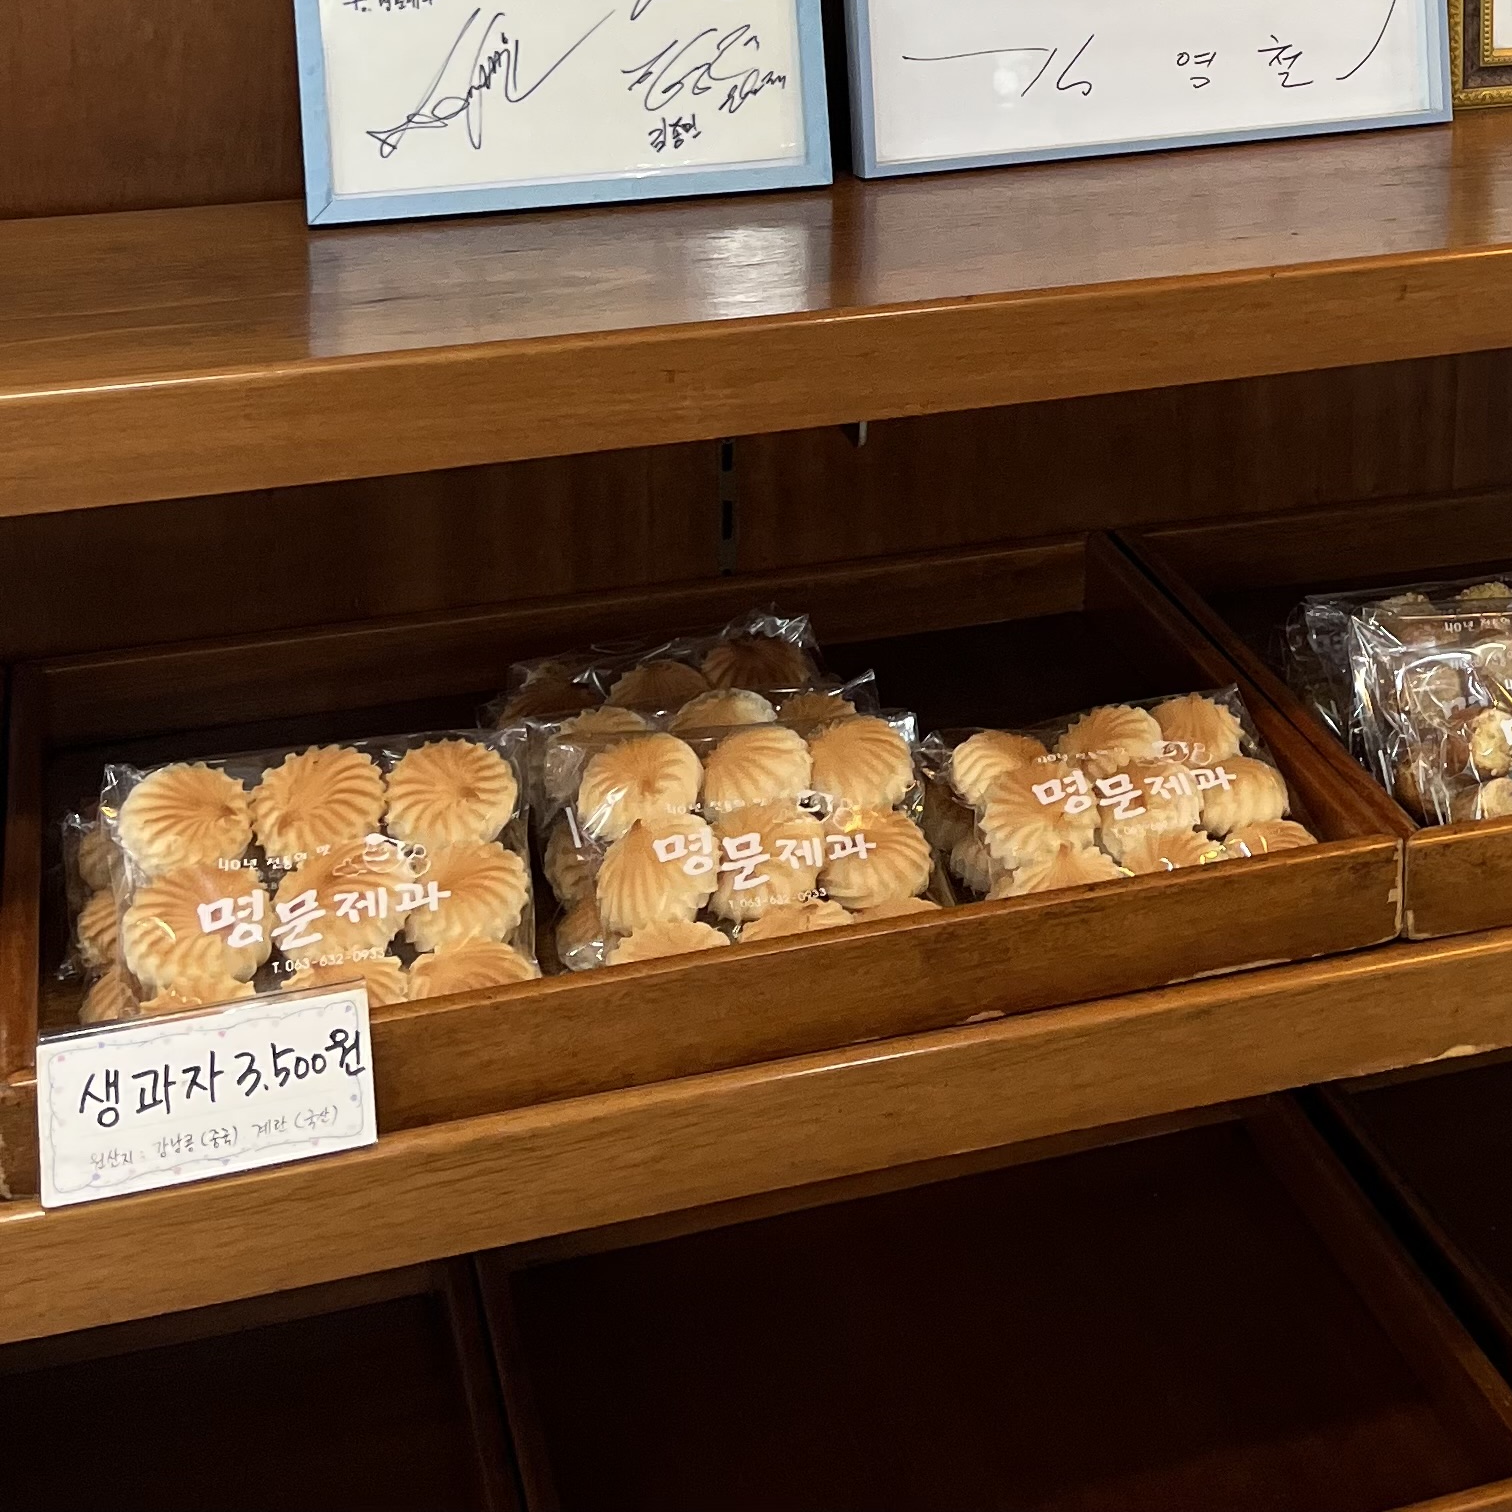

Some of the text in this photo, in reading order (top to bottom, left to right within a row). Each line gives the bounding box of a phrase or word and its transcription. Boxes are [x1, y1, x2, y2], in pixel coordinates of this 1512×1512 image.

[1031, 766, 1238, 821] 명문제과
[652, 827, 877, 890] 명문제과
[197, 879, 452, 951] 명문제과
[78, 1050, 225, 1128] 생과자
